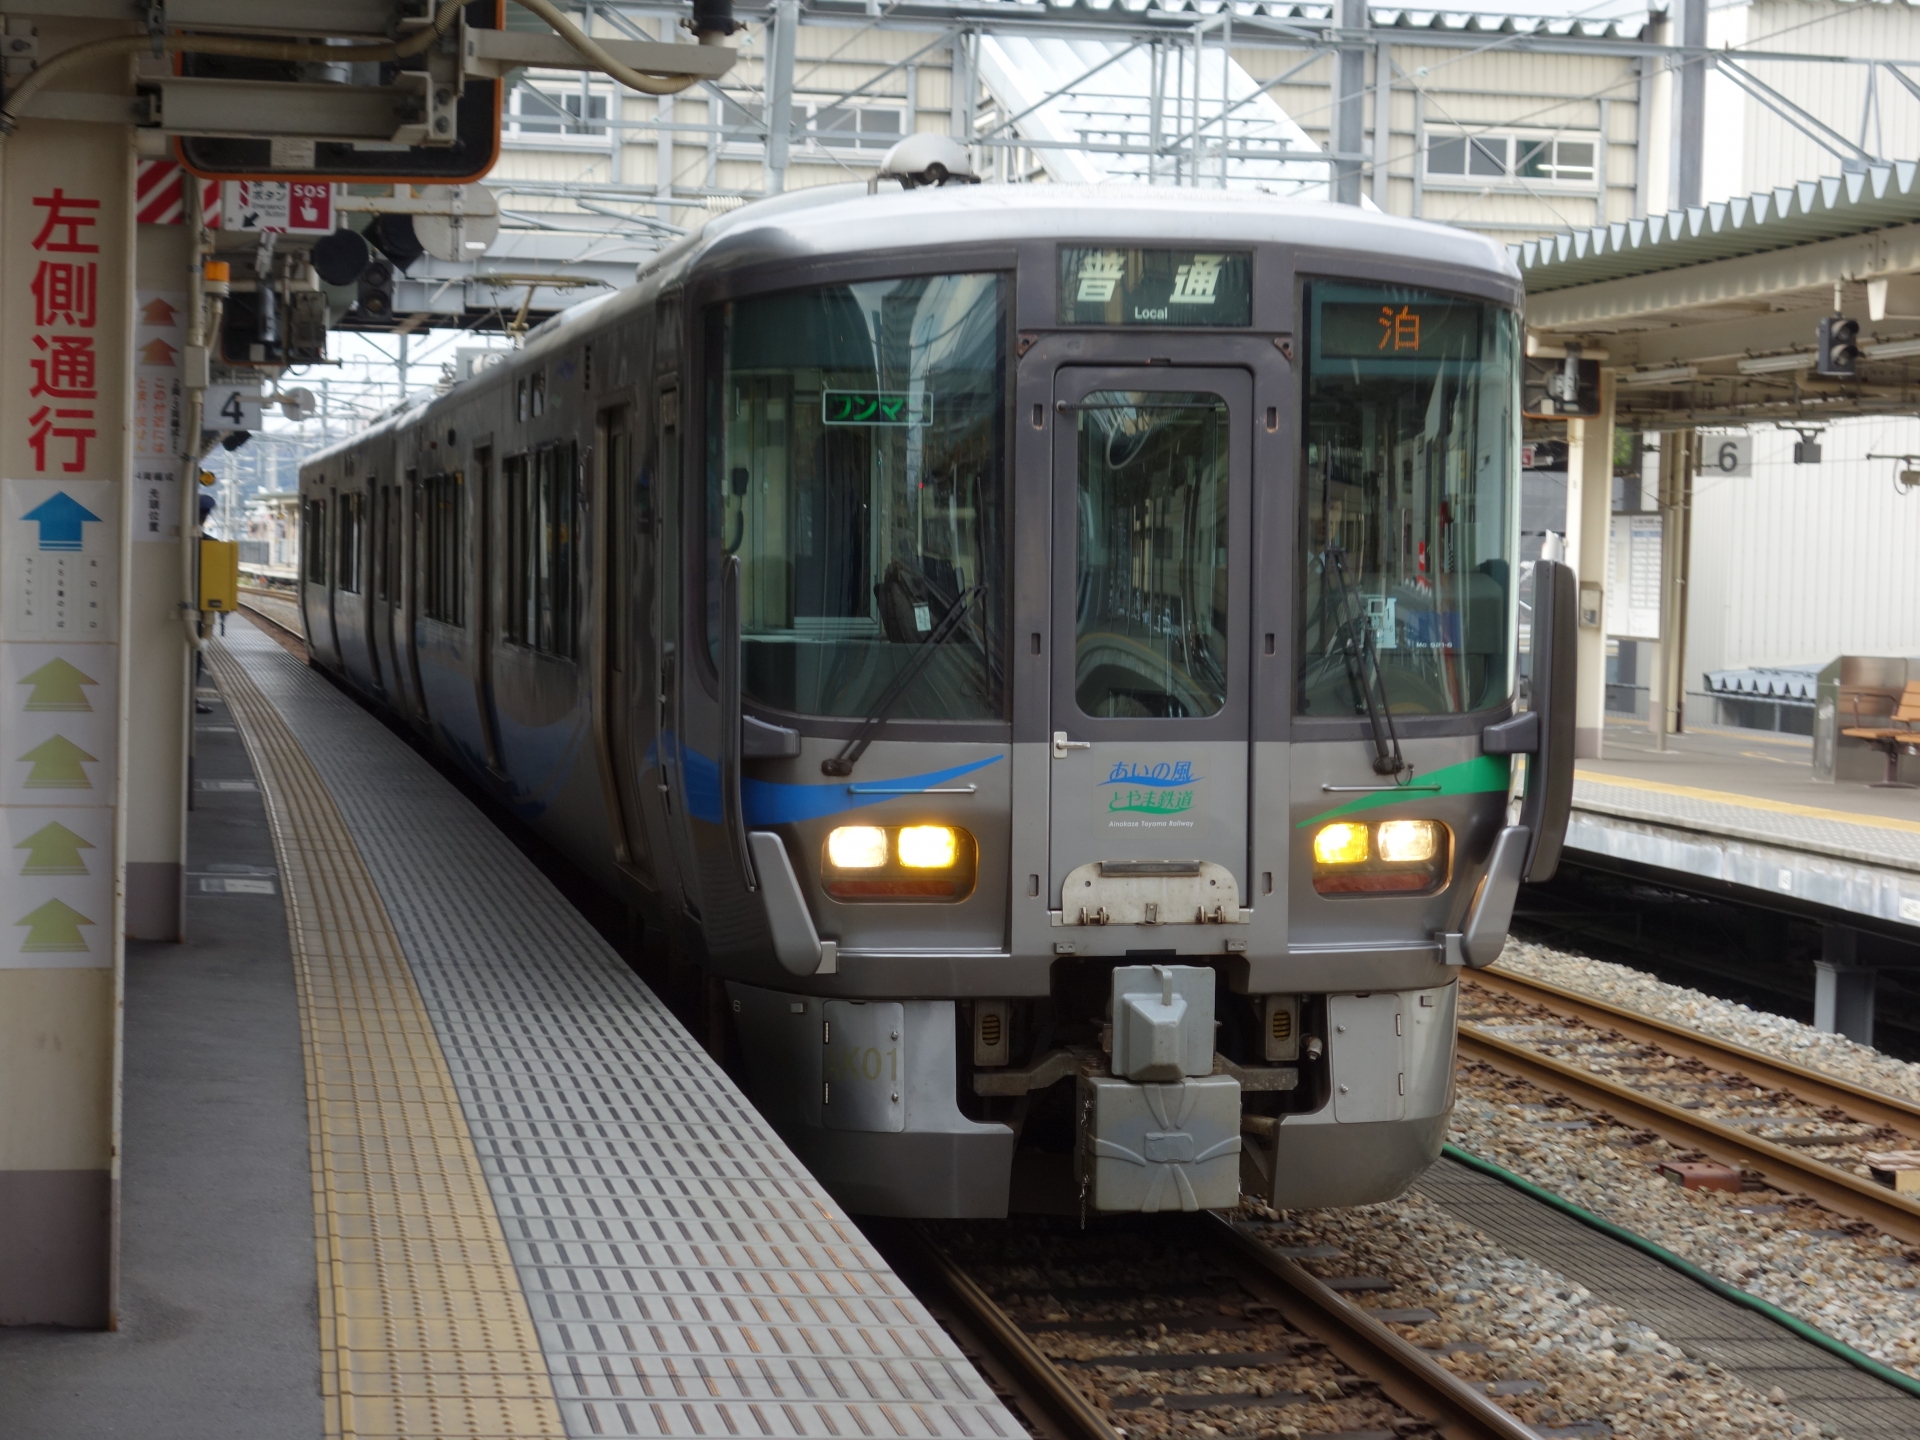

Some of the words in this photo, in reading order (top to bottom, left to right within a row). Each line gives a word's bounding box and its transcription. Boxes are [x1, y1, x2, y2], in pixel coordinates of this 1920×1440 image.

[293, 184, 326, 198] SOS
[1077, 253, 1225, 304] 普通
[1134, 306, 1168, 320] Local
[28, 188, 100, 472] 左側通行
[1379, 305, 1420, 351] 泊
[221, 390, 244, 425] 4
[1718, 441, 1738, 473] 6
[1109, 761, 1194, 782] あいの風
[1109, 790, 1194, 811] とやま鉄道
[1108, 820, 1139, 828] Ainokaze
[1141, 820, 1167, 829] Toyama
[1169, 820, 1195, 829] Railway
